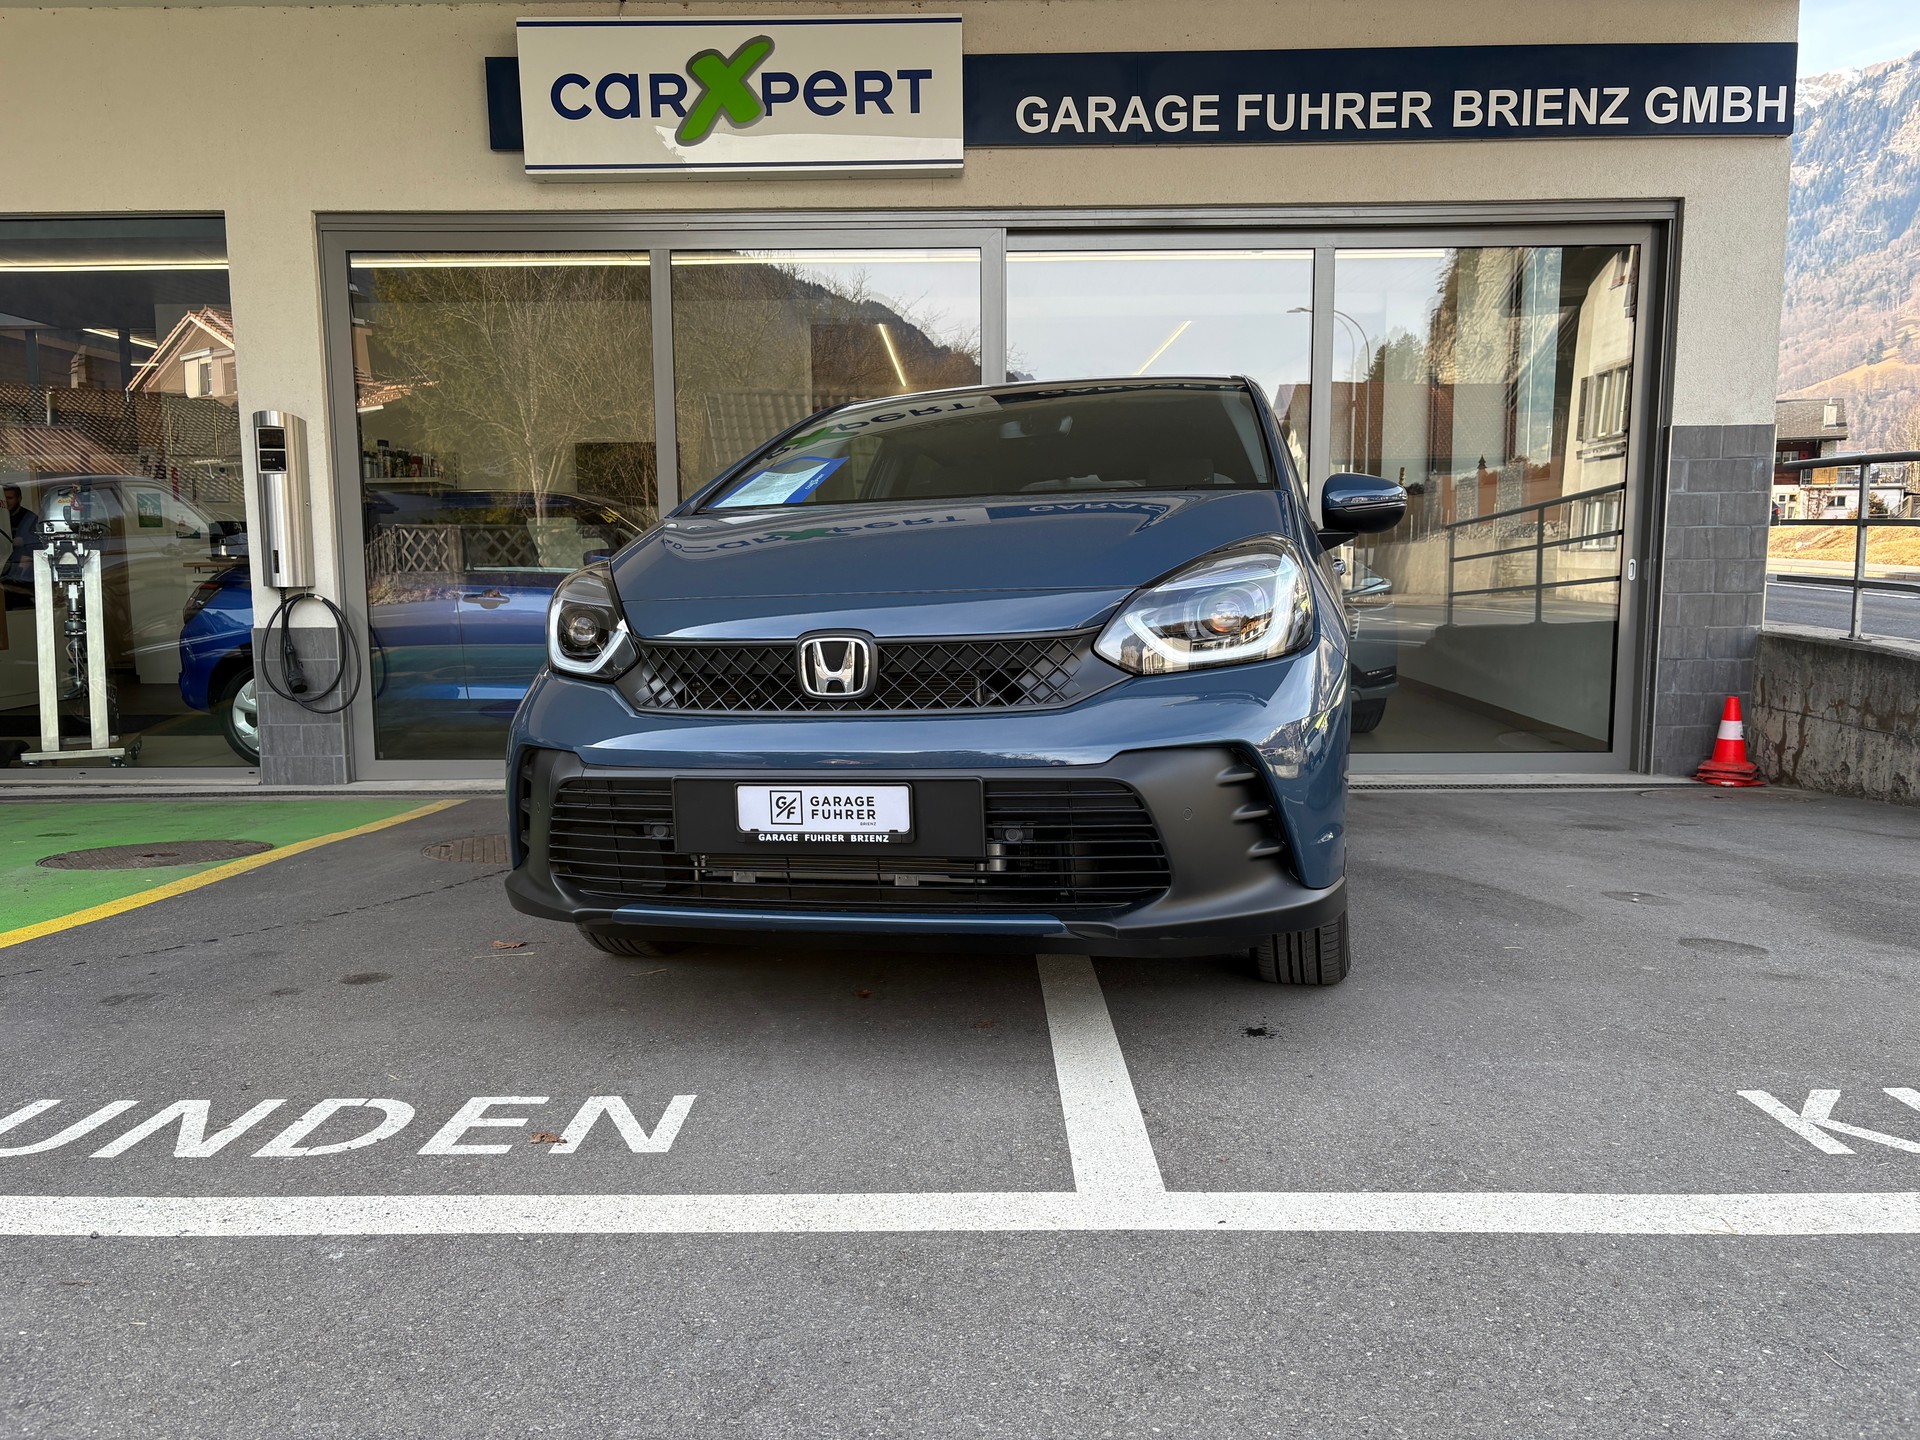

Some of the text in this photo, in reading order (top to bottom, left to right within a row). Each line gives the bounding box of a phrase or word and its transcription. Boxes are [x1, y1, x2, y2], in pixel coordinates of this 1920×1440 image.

[1015, 84, 1787, 134] GARAGE FUHRER BRIENZ GMBH
[810, 796, 875, 807] GARAGE
[811, 809, 876, 820] FUHRER
[758, 833, 799, 842] GARAGE
[804, 833, 845, 842] FUHRER
[850, 834, 889, 843] BRIENZ
